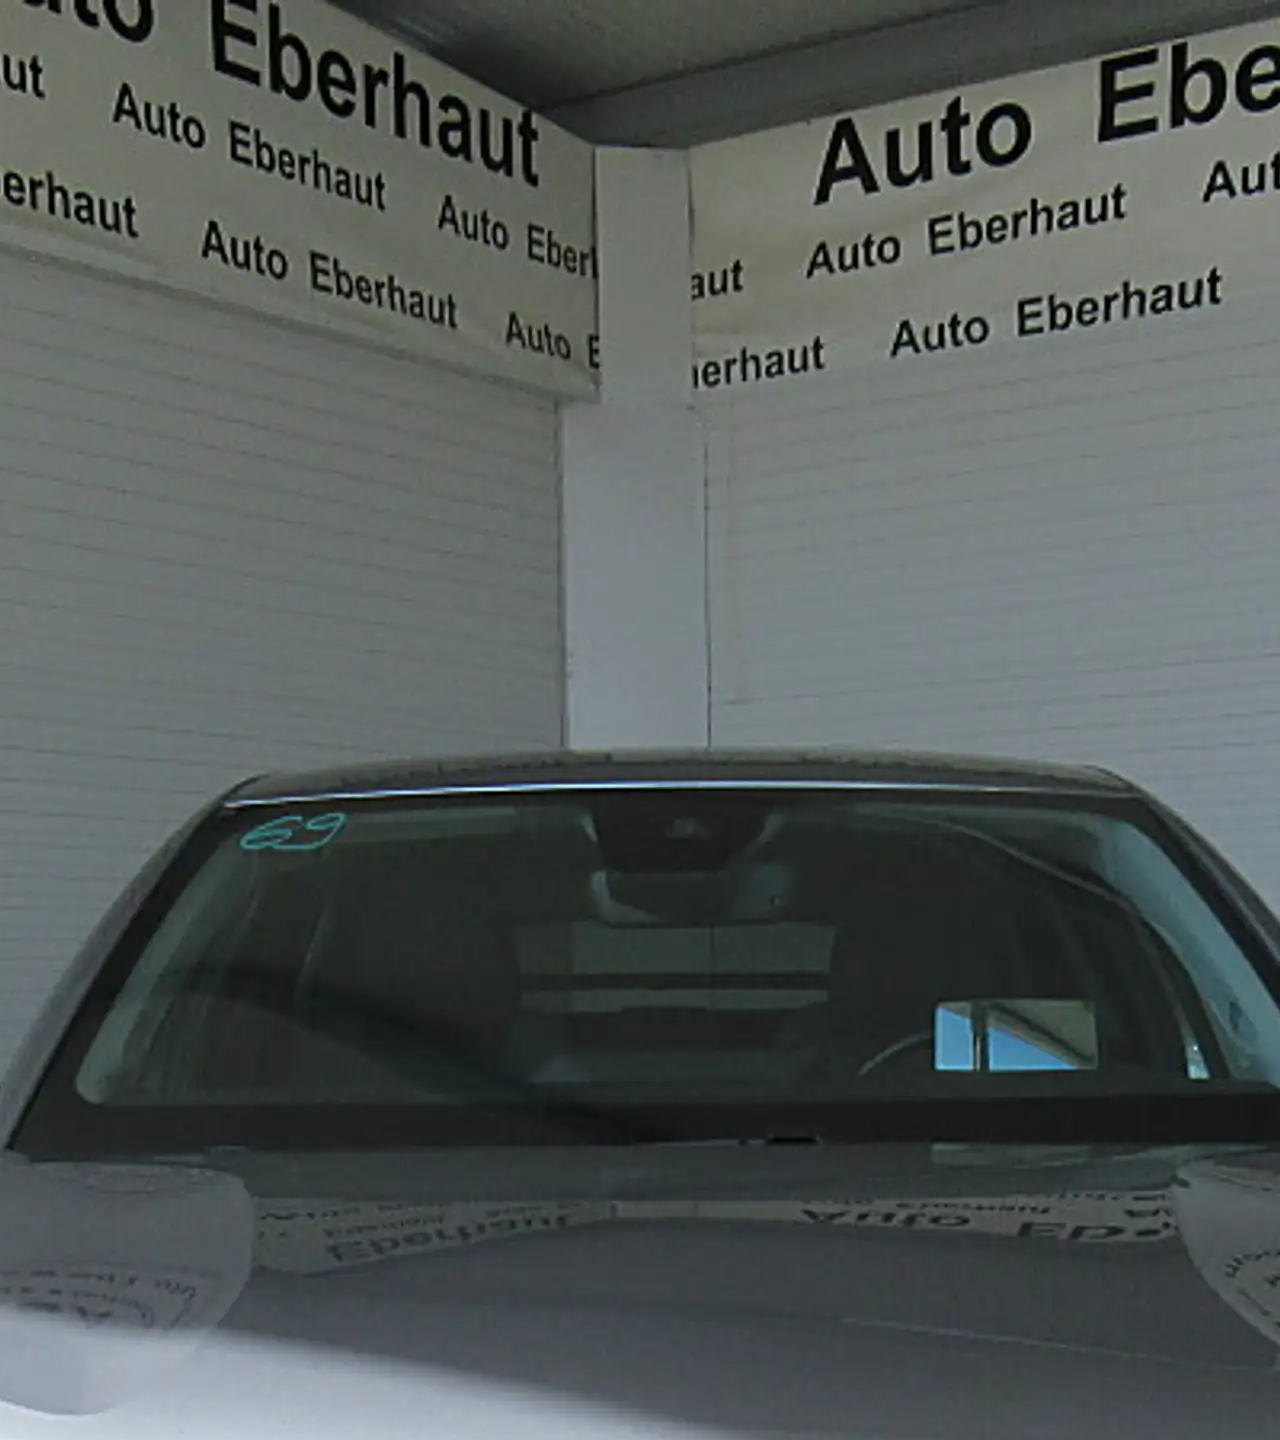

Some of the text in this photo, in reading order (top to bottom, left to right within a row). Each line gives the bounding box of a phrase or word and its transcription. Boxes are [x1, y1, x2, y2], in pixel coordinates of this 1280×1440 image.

[211, 0, 539, 187] Eberhaut
[113, 83, 386, 211] Auto Eberhaut
[815, 96, 1032, 204] Auto
[438, 195, 509, 250] Auto
[807, 184, 1127, 279] Auto Eberhaut
[202, 220, 458, 329] Auto Eberhaut
[890, 268, 1223, 358] Auto Eberhaut
[506, 311, 571, 360] Auto
